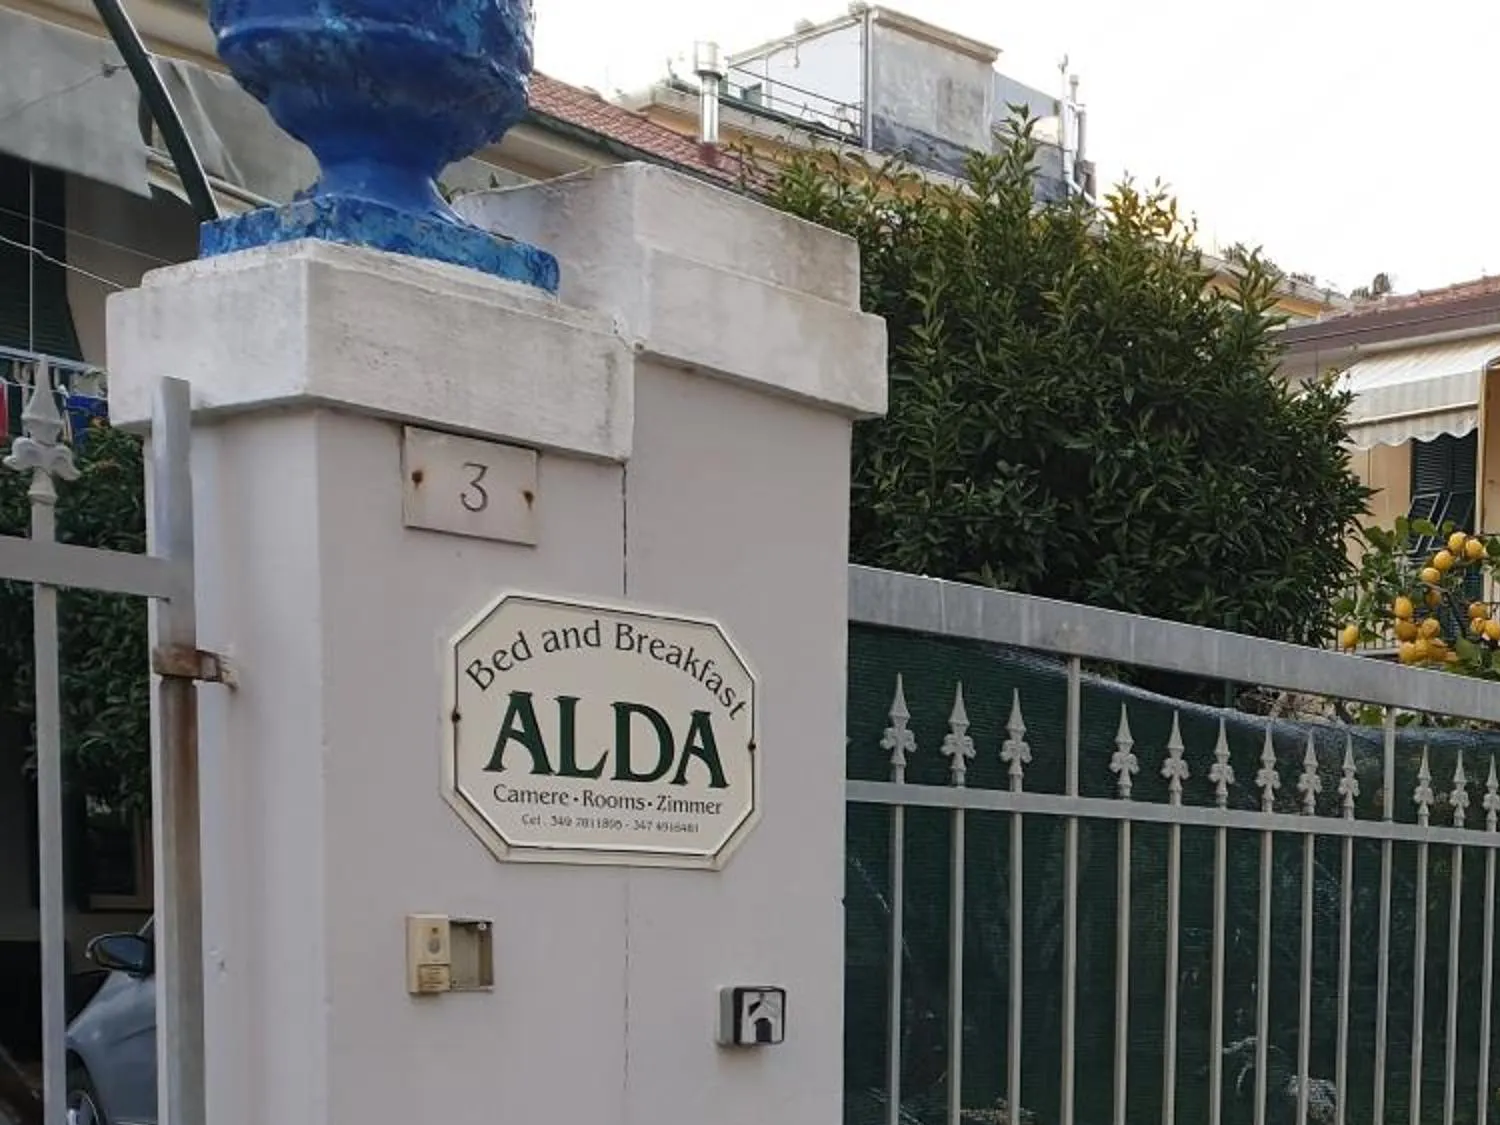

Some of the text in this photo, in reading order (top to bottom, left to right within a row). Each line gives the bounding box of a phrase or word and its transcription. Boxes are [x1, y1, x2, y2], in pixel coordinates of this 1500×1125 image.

[460, 461, 489, 513] 3
[465, 619, 748, 719] Bed and Breakfast
[482, 690, 731, 789] ALDA
[492, 783, 722, 815] Camere Rooms Zimmer
